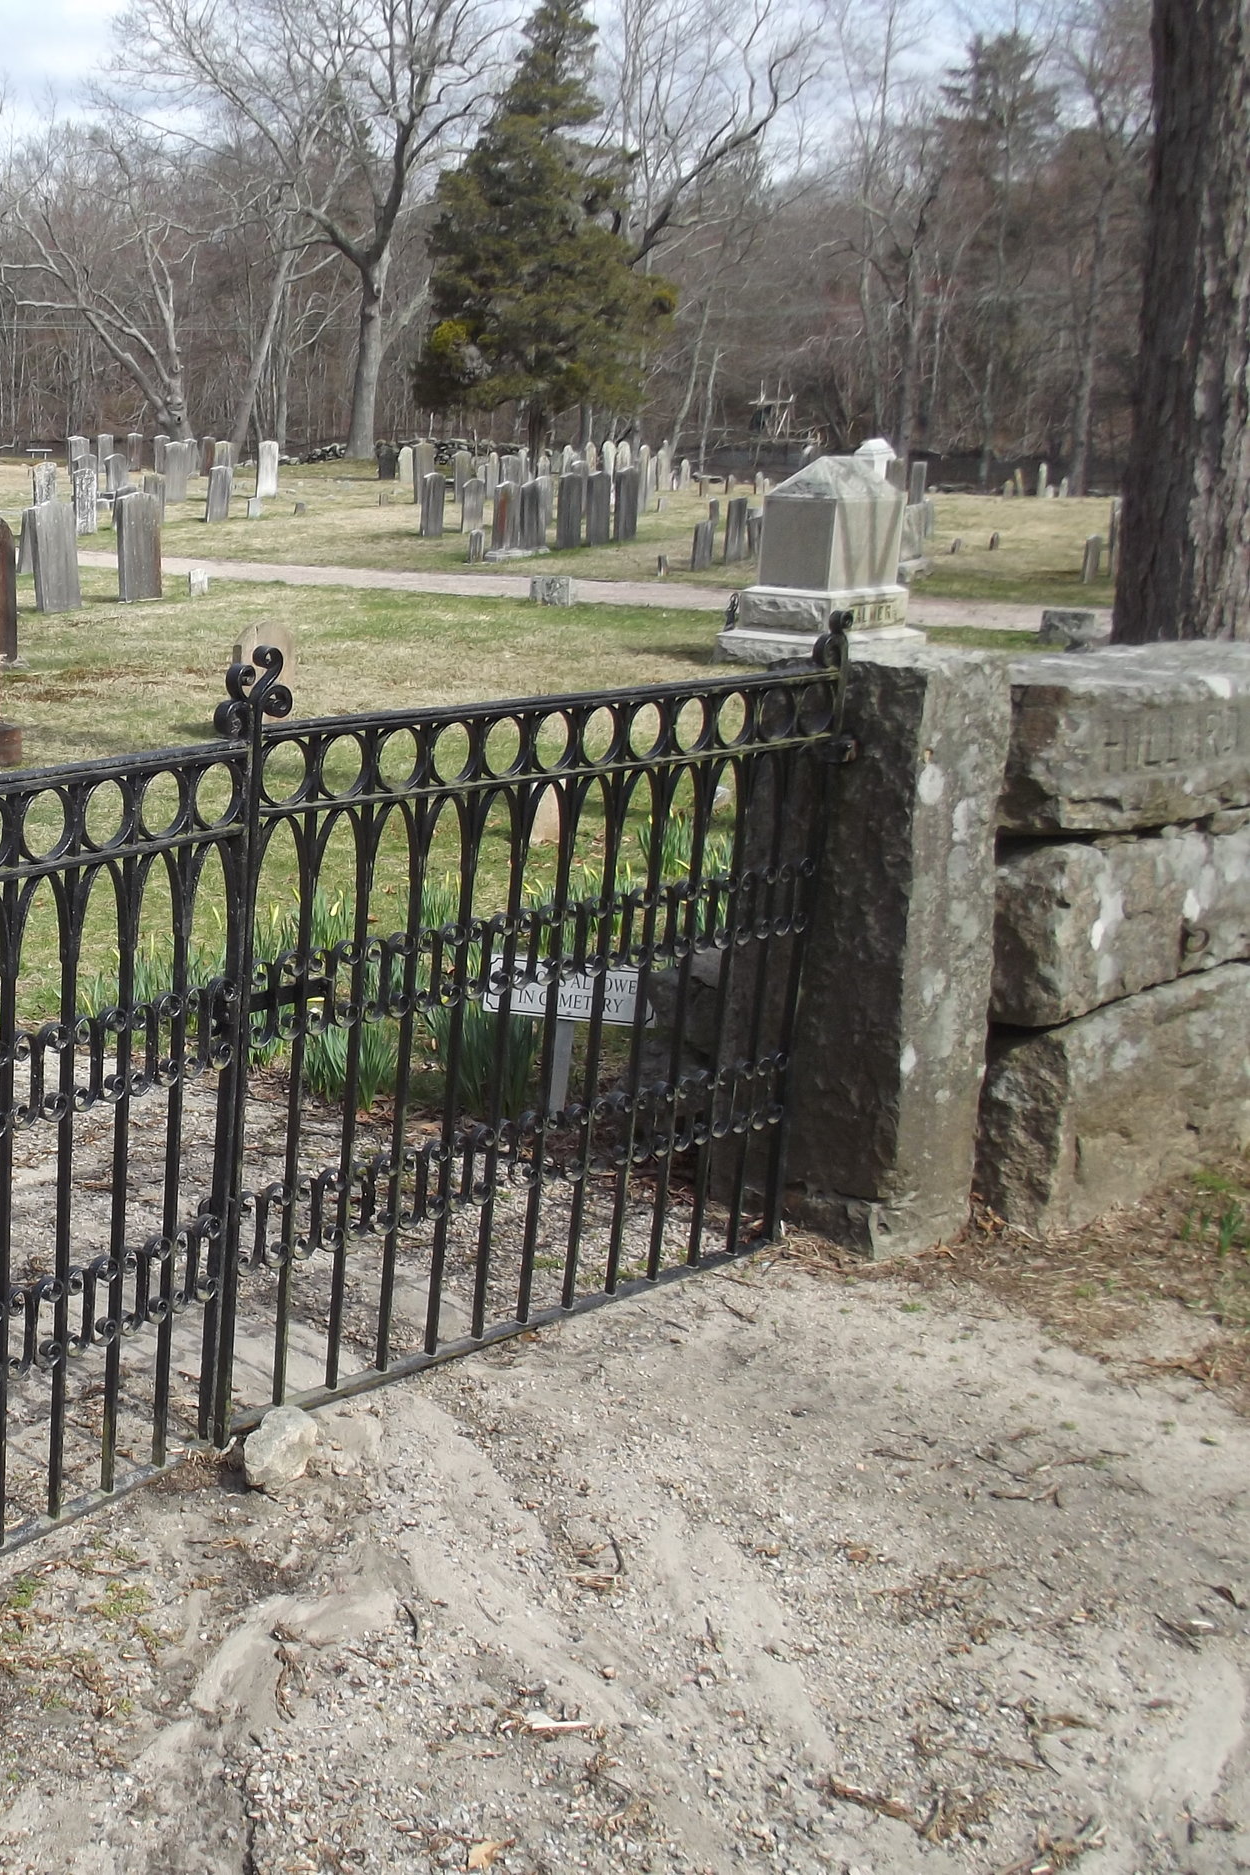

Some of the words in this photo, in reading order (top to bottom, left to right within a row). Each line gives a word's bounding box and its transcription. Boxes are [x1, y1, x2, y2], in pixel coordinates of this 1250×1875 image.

[853, 604, 892, 624] ALMER
[570, 973, 638, 995] ALOWE
[518, 989, 535, 1005] IN
[538, 990, 625, 1014] CMETRY
